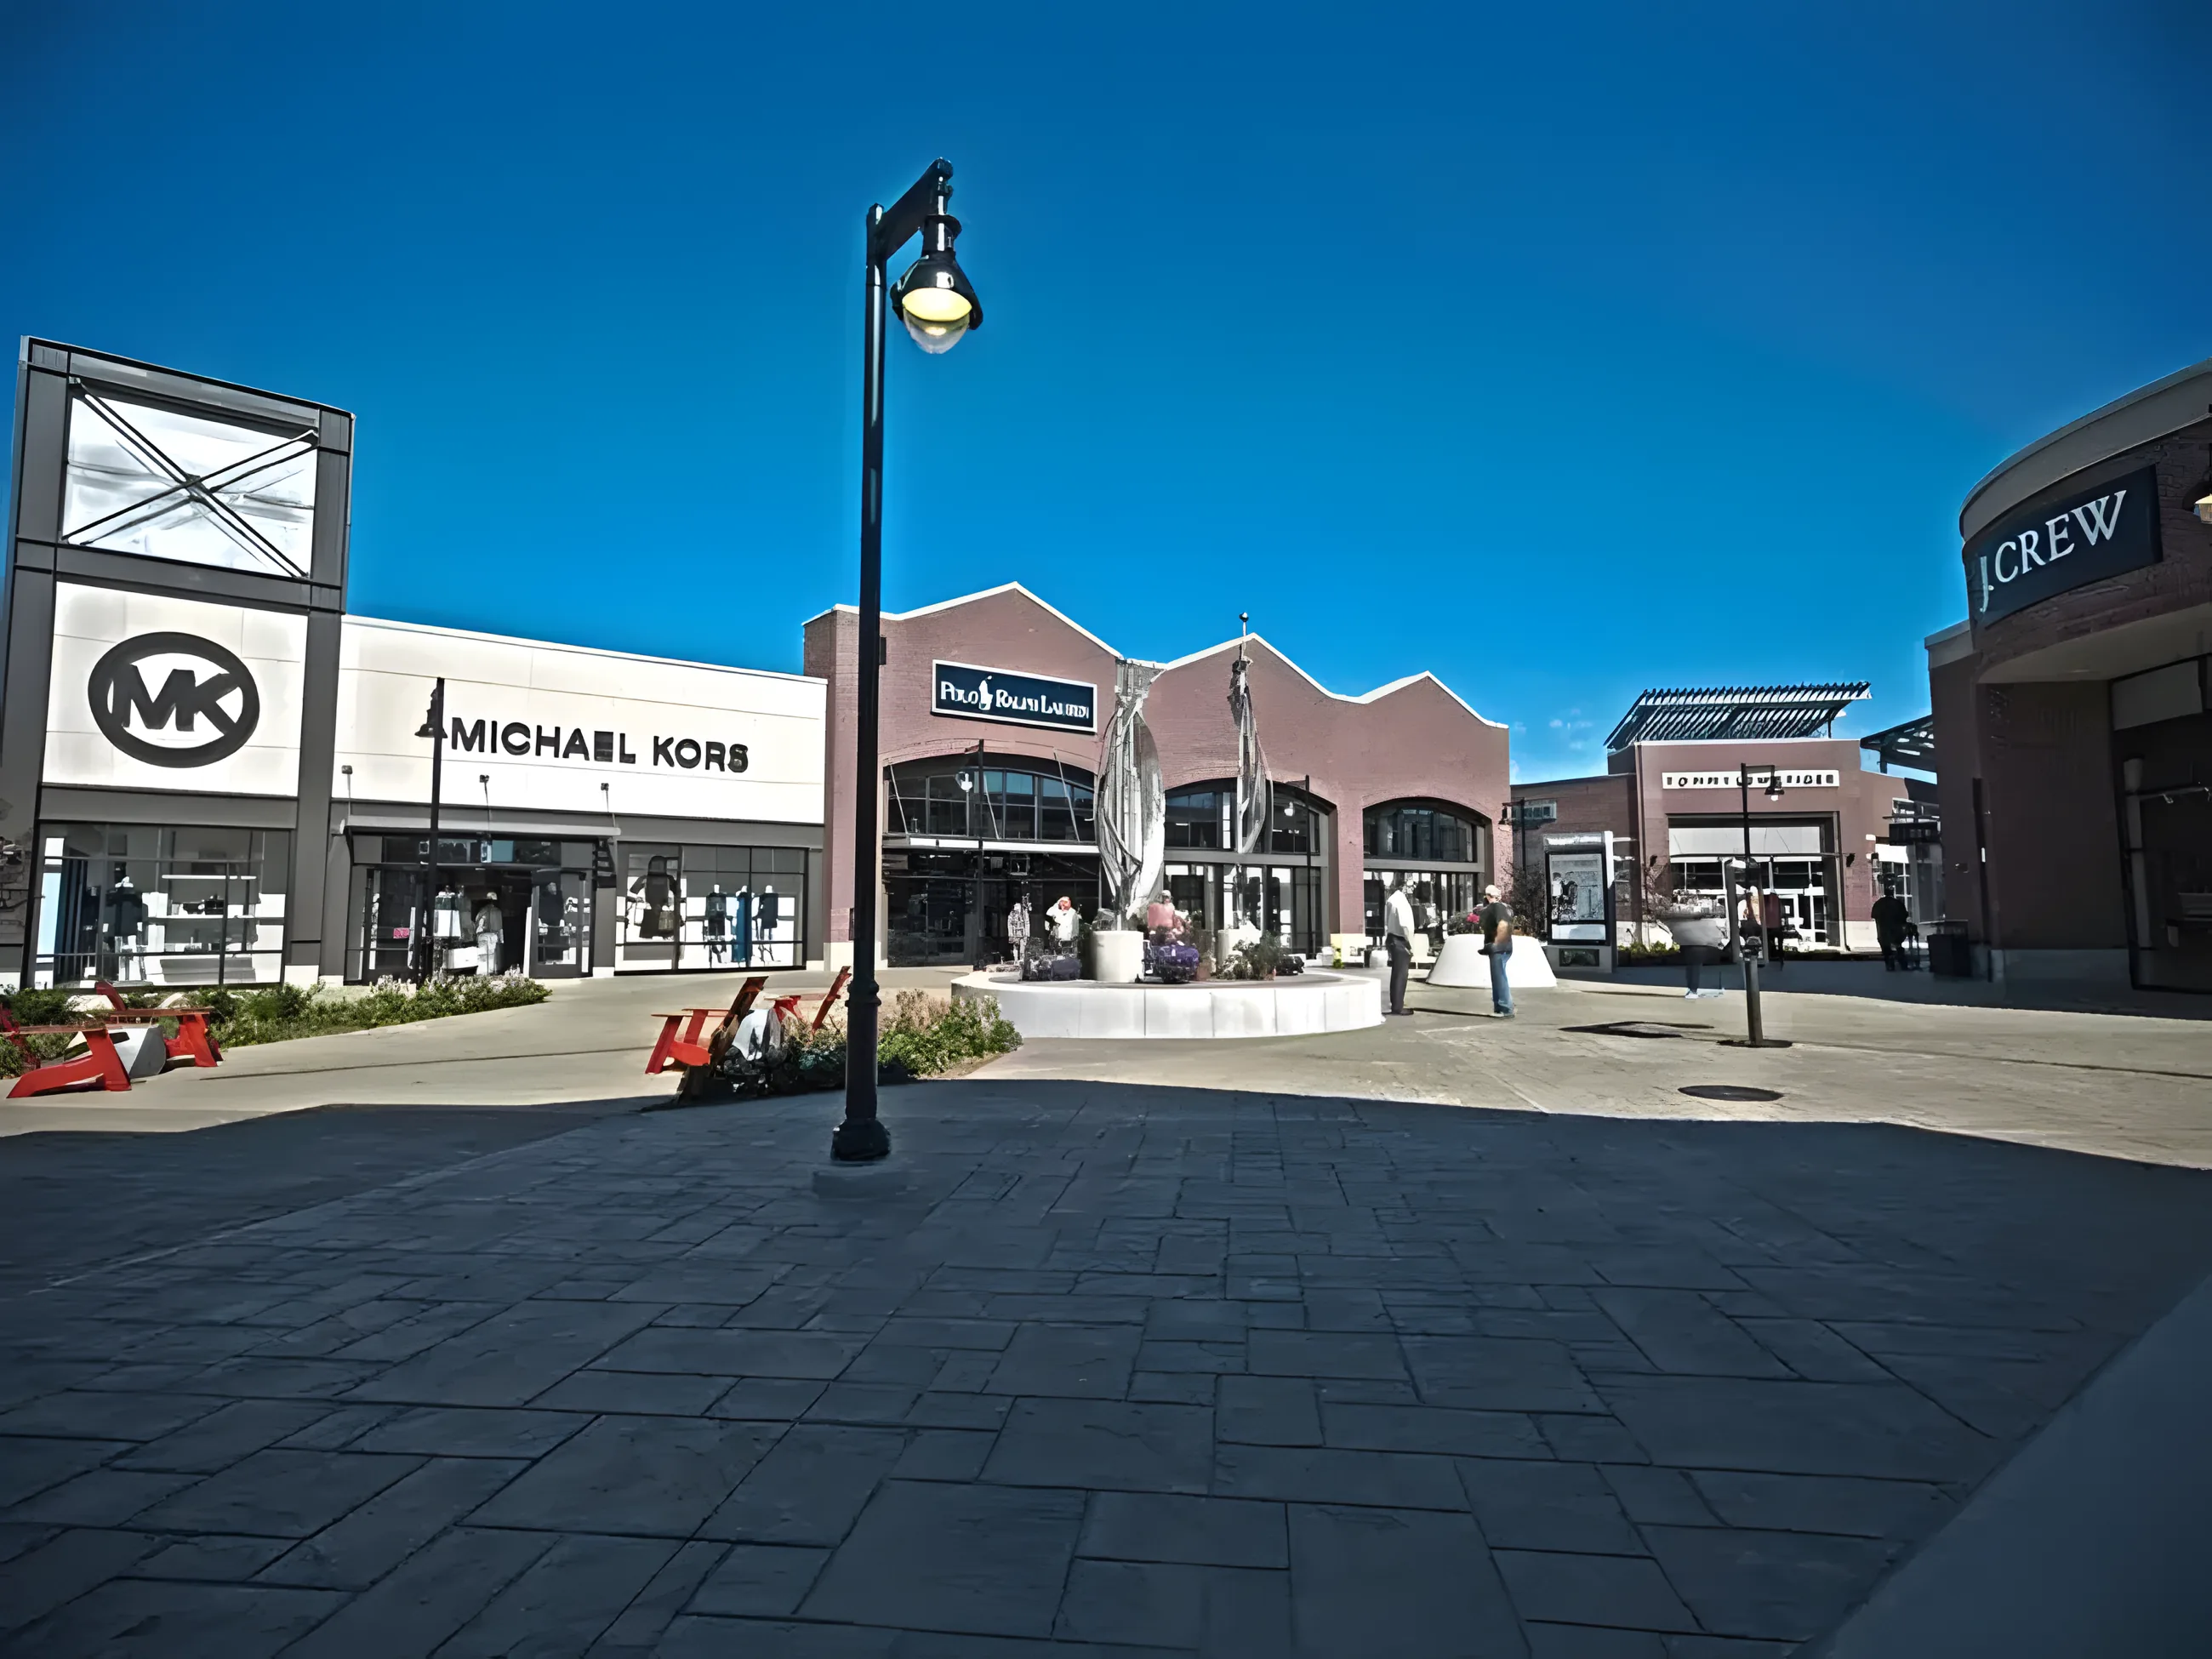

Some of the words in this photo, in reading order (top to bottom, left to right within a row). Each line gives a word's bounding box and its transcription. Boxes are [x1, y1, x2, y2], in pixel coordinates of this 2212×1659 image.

[1979, 489, 2127, 613] J.CREW
[108, 652, 243, 737] MK
[451, 716, 636, 764] MICHAEL
[653, 735, 749, 773] KORS
